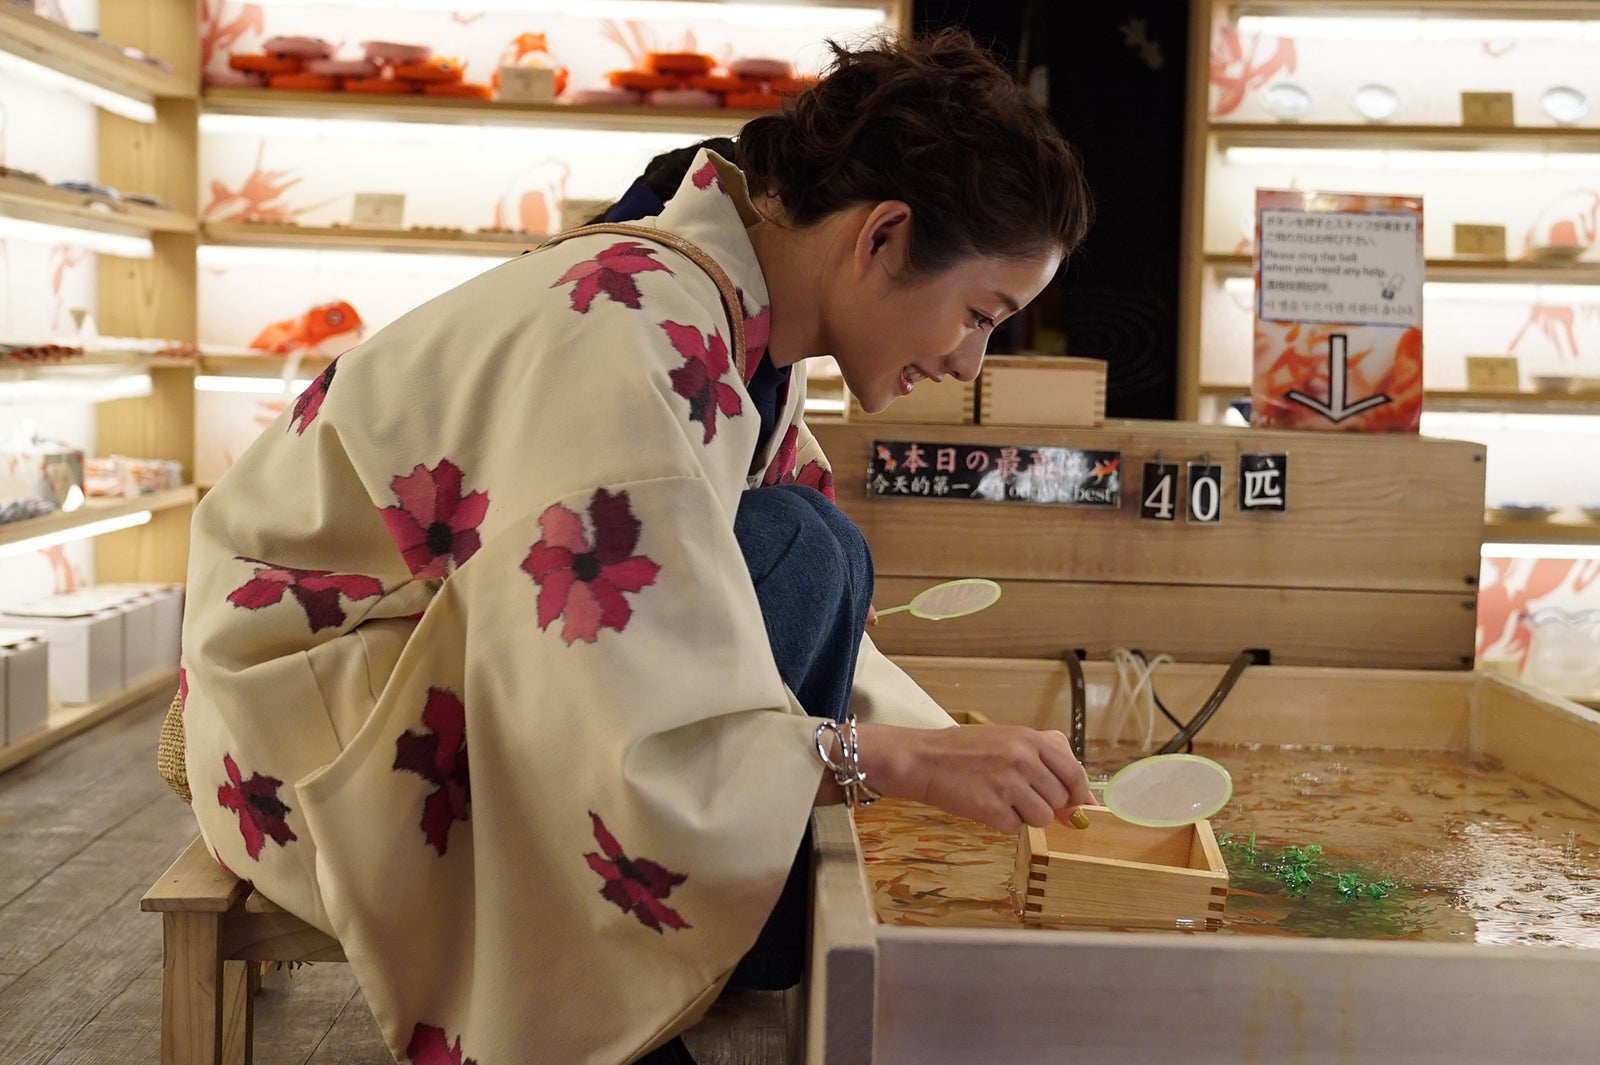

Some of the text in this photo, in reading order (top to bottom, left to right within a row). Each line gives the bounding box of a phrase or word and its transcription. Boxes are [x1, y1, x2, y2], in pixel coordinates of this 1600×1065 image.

[1264, 249, 1295, 260] Please
[1298, 251, 1317, 263] ring
[1320, 252, 1336, 261] the
[1264, 263, 1291, 272] when
[1295, 265, 1313, 274] you
[1315, 265, 1340, 274] need
[1343, 268, 1360, 277] any
[1244, 469, 1283, 507] 匹
